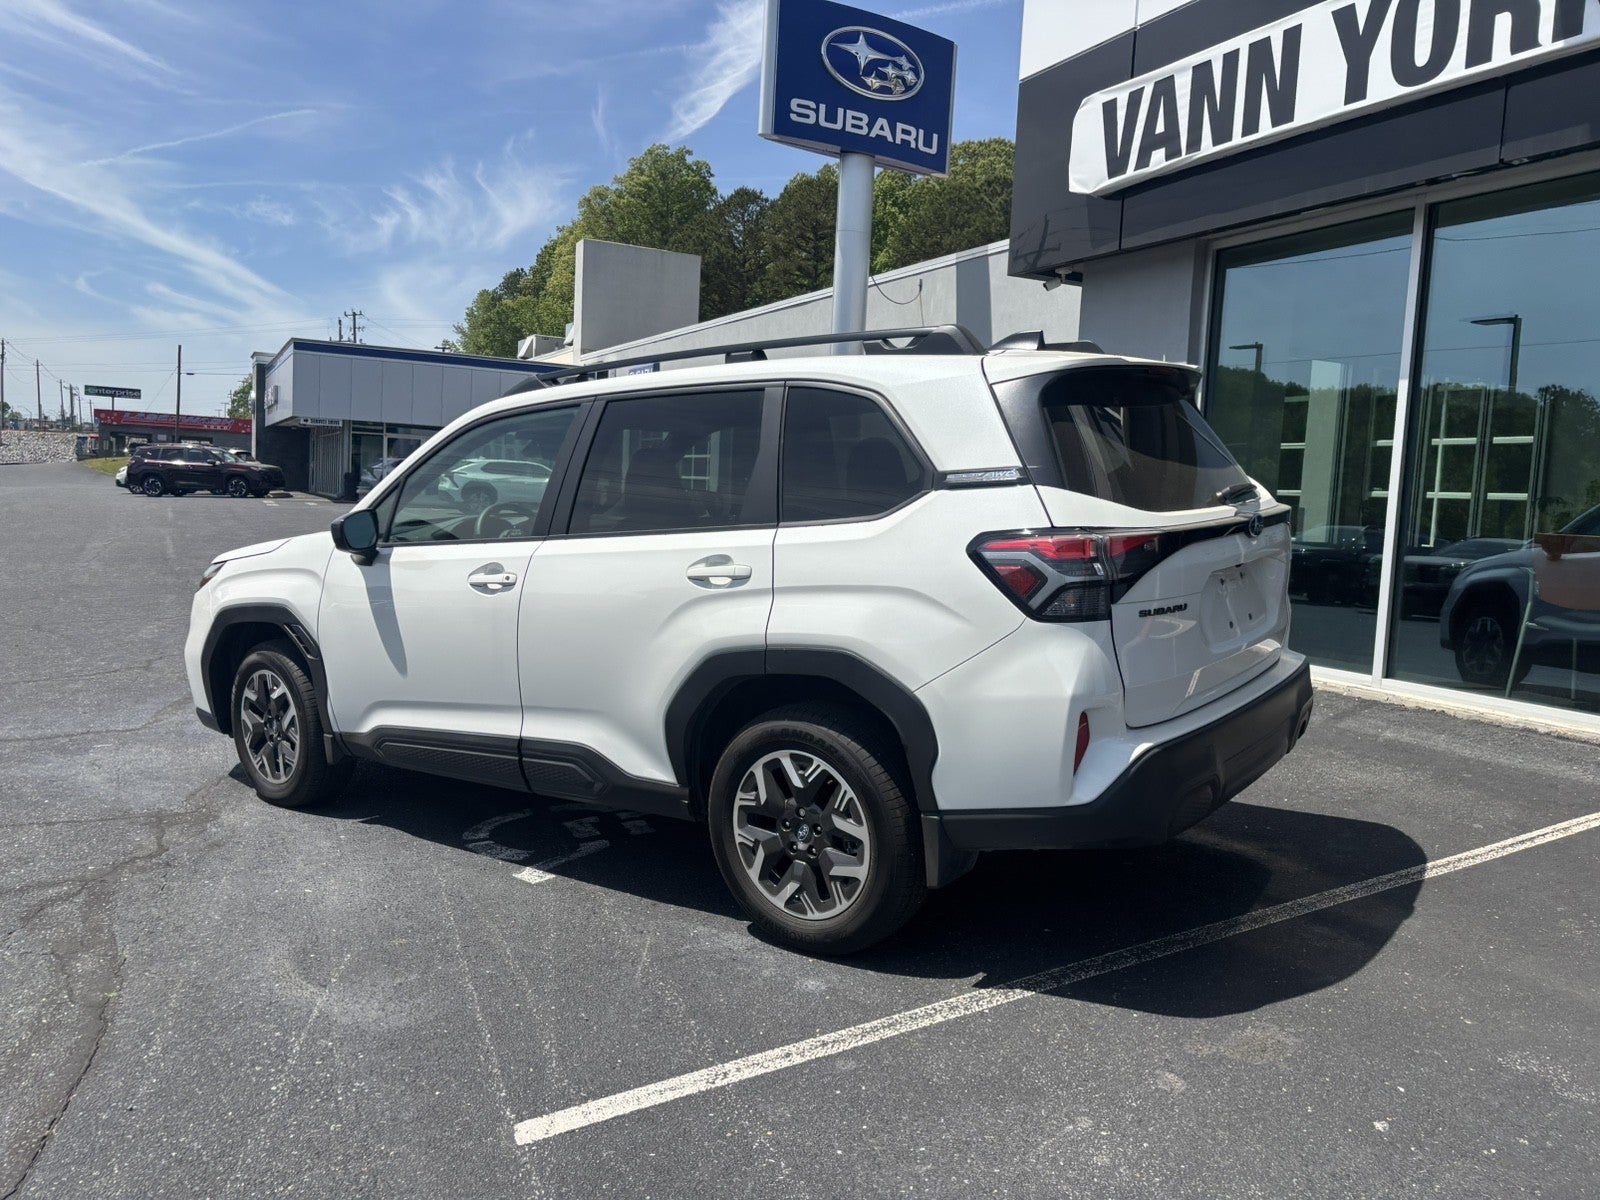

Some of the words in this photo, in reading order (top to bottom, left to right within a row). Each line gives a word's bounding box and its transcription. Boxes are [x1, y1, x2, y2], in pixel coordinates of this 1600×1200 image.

[1101, 22, 1302, 180] VANN
[789, 97, 939, 155] SUBARU
[87, 386, 140, 397] enterprise
[1138, 602, 1188, 618] SUBARU
